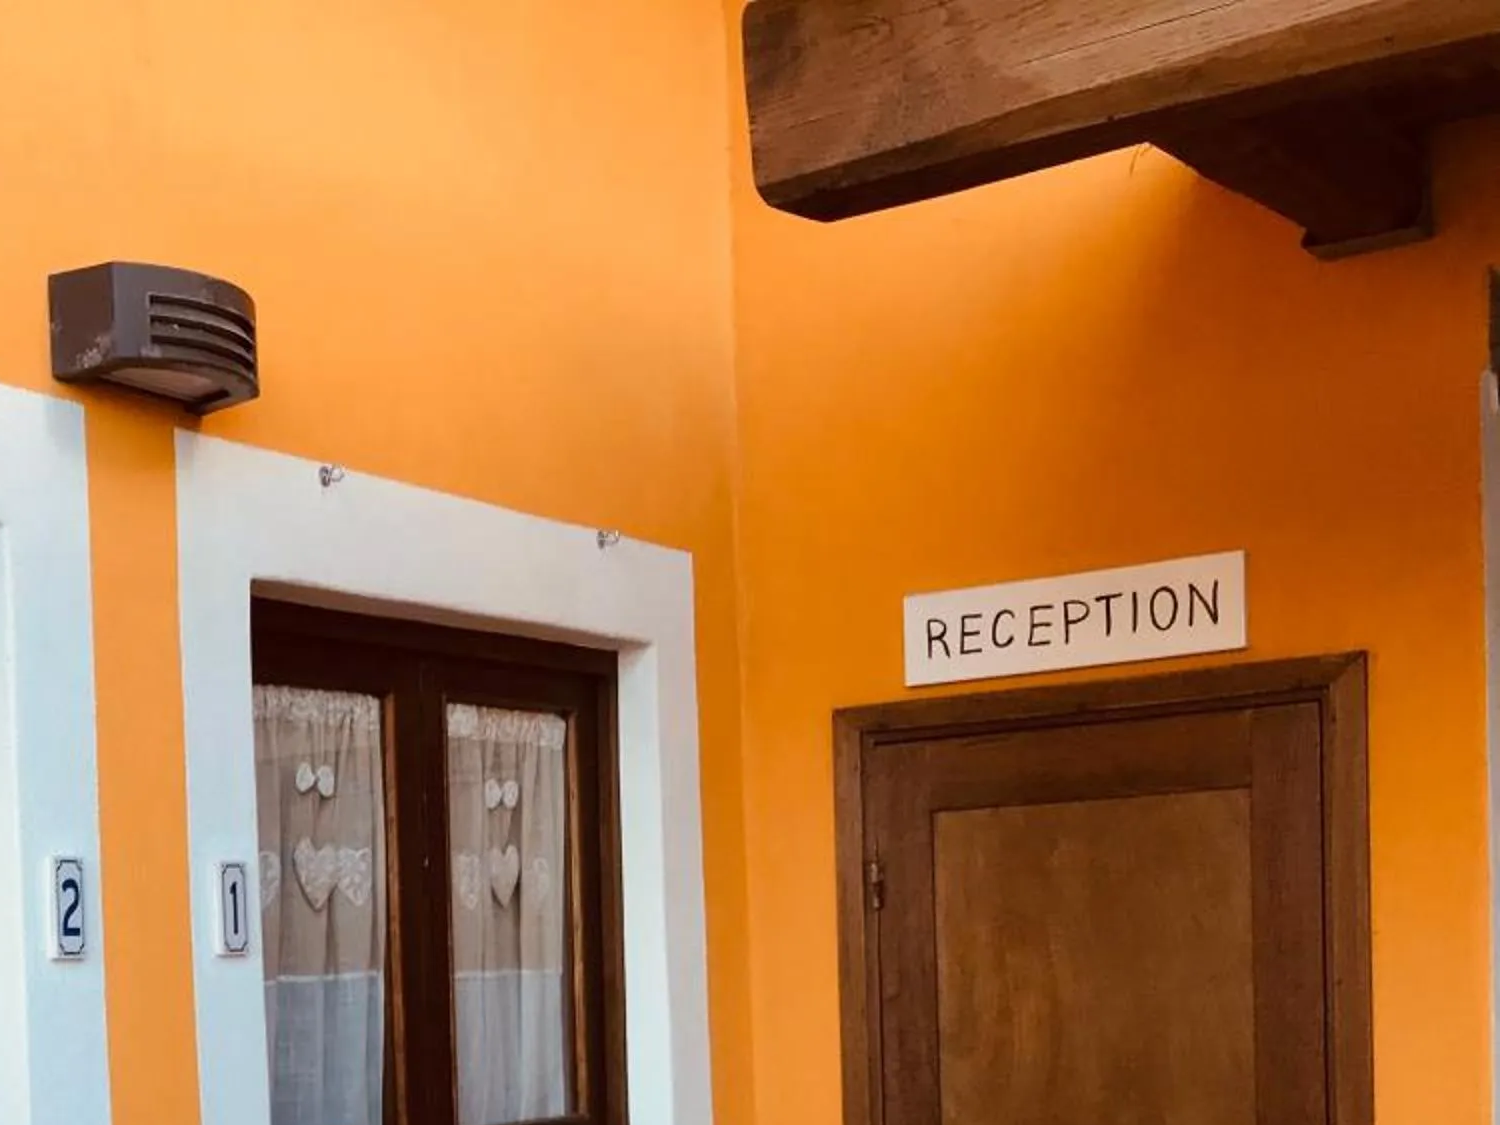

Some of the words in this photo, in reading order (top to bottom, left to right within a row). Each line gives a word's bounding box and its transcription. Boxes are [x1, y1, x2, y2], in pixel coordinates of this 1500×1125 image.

[927, 580, 1219, 658] RECEPTION
[62, 878, 80, 936] 2
[229, 881, 238, 935] 1
